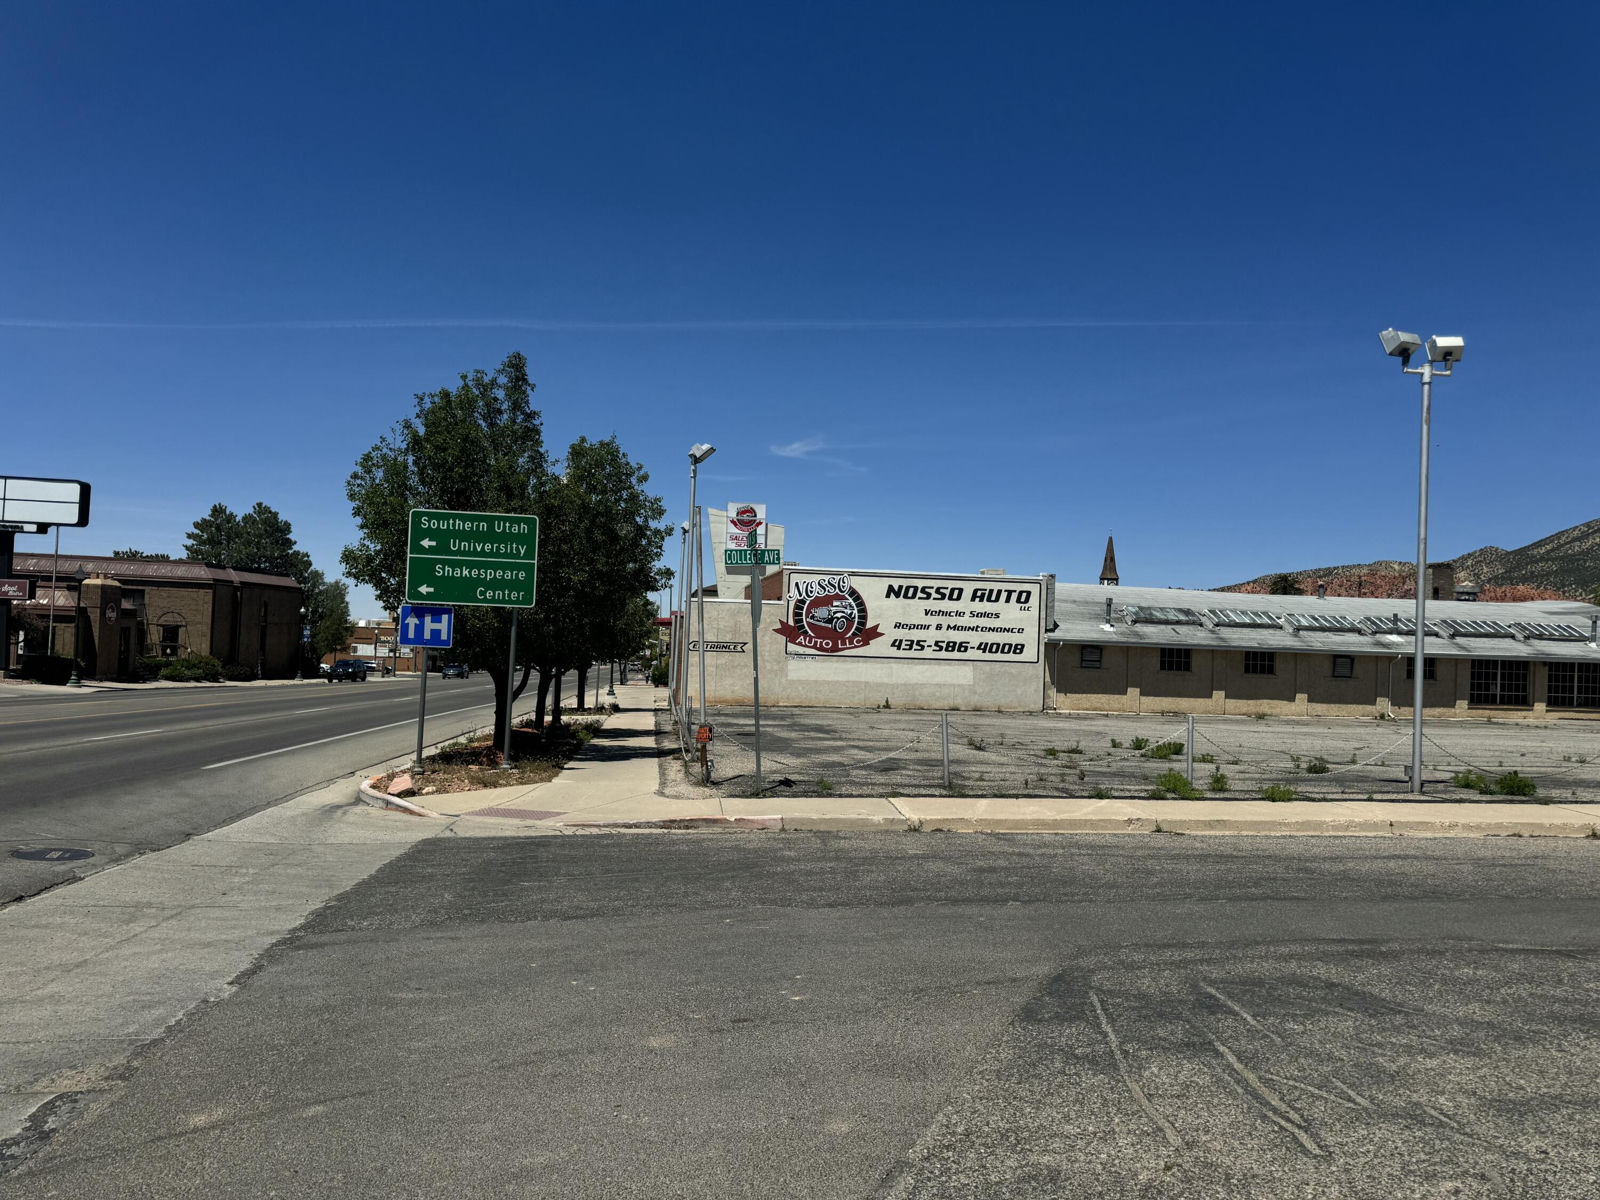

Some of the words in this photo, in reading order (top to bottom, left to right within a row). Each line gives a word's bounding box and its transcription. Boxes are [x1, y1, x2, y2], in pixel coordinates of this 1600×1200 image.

[420, 516, 487, 531] Southern
[494, 520, 528, 533] Utah
[450, 538, 526, 556] University
[726, 550, 762, 564] COLLEGE
[764, 550, 779, 564] AVE
[435, 564, 526, 581] Shakespeare
[476, 587, 525, 601] Center
[787, 573, 851, 601] NOSSO
[885, 584, 964, 602] NOSSO
[970, 588, 1032, 605] AUTO
[924, 608, 966, 618] Vehicle
[969, 610, 1001, 619] Sales
[423, 613, 449, 641] H
[893, 621, 933, 632] Repair
[935, 623, 943, 632] &
[946, 623, 1025, 634] Maintenance
[692, 642, 739, 651] ETRANCE
[796, 635, 832, 649] AUTO
[838, 636, 863, 649] LLC
[890, 638, 1026, 655] 435-586-4008
